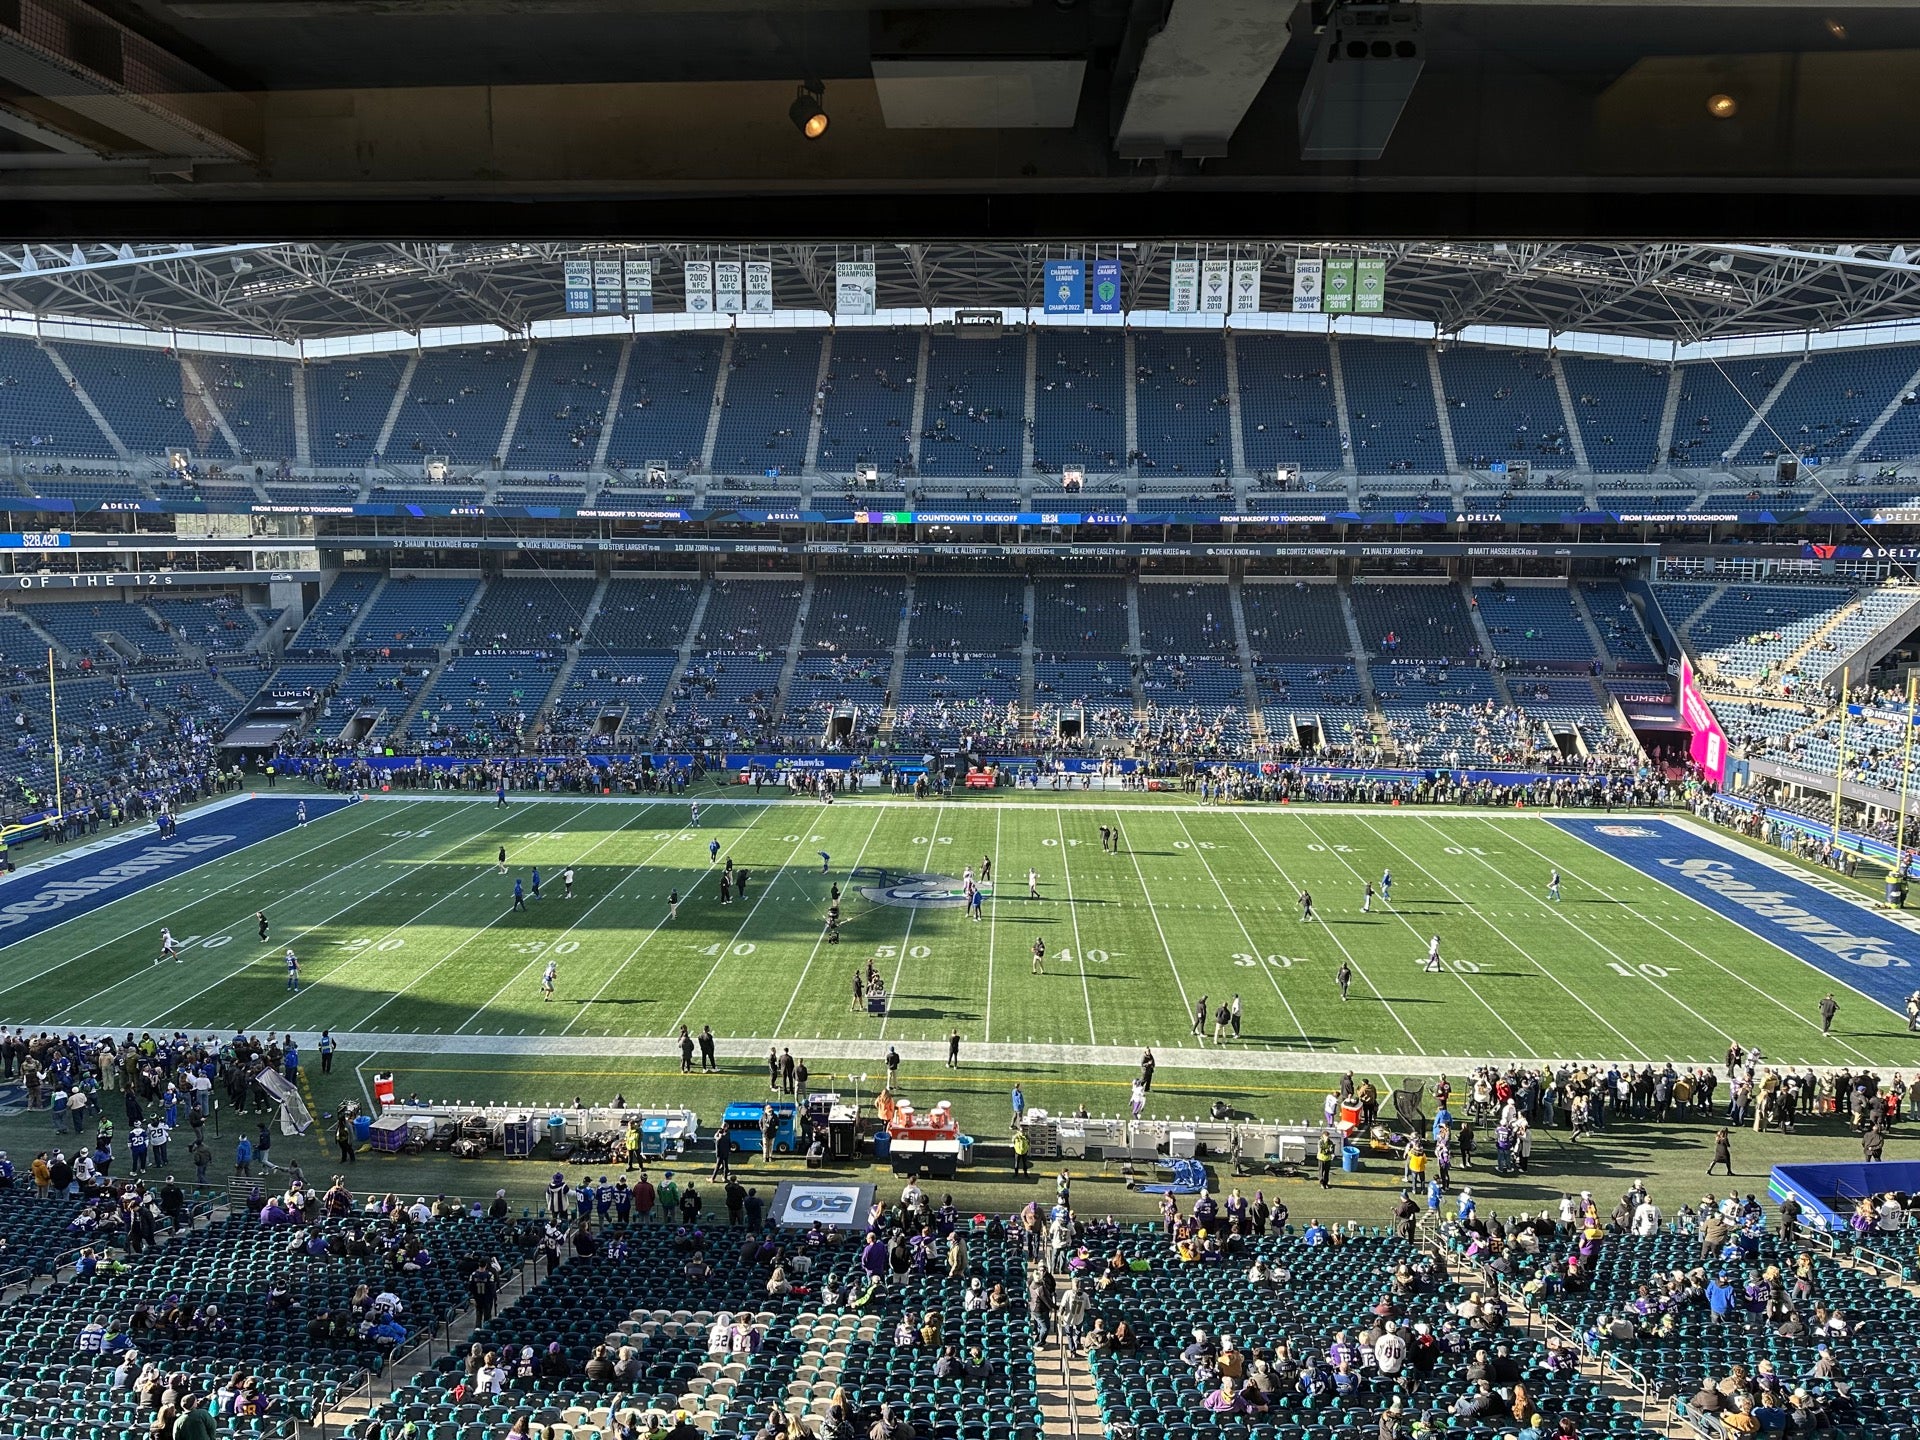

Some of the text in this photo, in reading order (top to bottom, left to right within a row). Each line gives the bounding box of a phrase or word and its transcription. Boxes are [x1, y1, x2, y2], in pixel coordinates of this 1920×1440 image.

[689, 273, 707, 282] 2005
[719, 274, 737, 283] 2013
[749, 274, 767, 283] 2014
[837, 270, 874, 278] CHAMPIONS
[569, 291, 588, 299] 1988
[570, 301, 589, 309] 1999
[1361, 300, 1377, 308] 2019
[1467, 514, 1502, 522] DELTA
[1643, 514, 1675, 522] TAKEOFF
[1676, 514, 1687, 522] TO
[1687, 514, 1738, 522] TOUCHDOWN
[20, 575, 172, 589] OF THE 12s
[1808, 776, 1823, 785] BANK
[1655, 857, 1911, 968] Seahawks
[340, 938, 404, 952] 20
[519, 941, 581, 954] 30
[698, 943, 757, 956] 40
[874, 945, 932, 959] 50
[1051, 948, 1112, 963] 40
[1231, 953, 1295, 968] 30
[1606, 962, 1669, 978] 10
[150, 1128, 164, 1138] 29
[131, 1136, 144, 1147] 29
[614, 1193, 628, 1204] 37
[791, 1195, 853, 1213] 50
[945, 1215, 953, 1223] 14
[1647, 1213, 1654, 1222] 9
[1890, 1211, 1900, 1220] 87
[608, 1250, 620, 1259] 54
[1553, 1284, 1561, 1293] 11
[1757, 1291, 1769, 1302] 22
[80, 1333, 102, 1351] 55
[714, 1335, 728, 1347] 22
[732, 1333, 752, 1352] 84
[1364, 1353, 1377, 1368] 12
